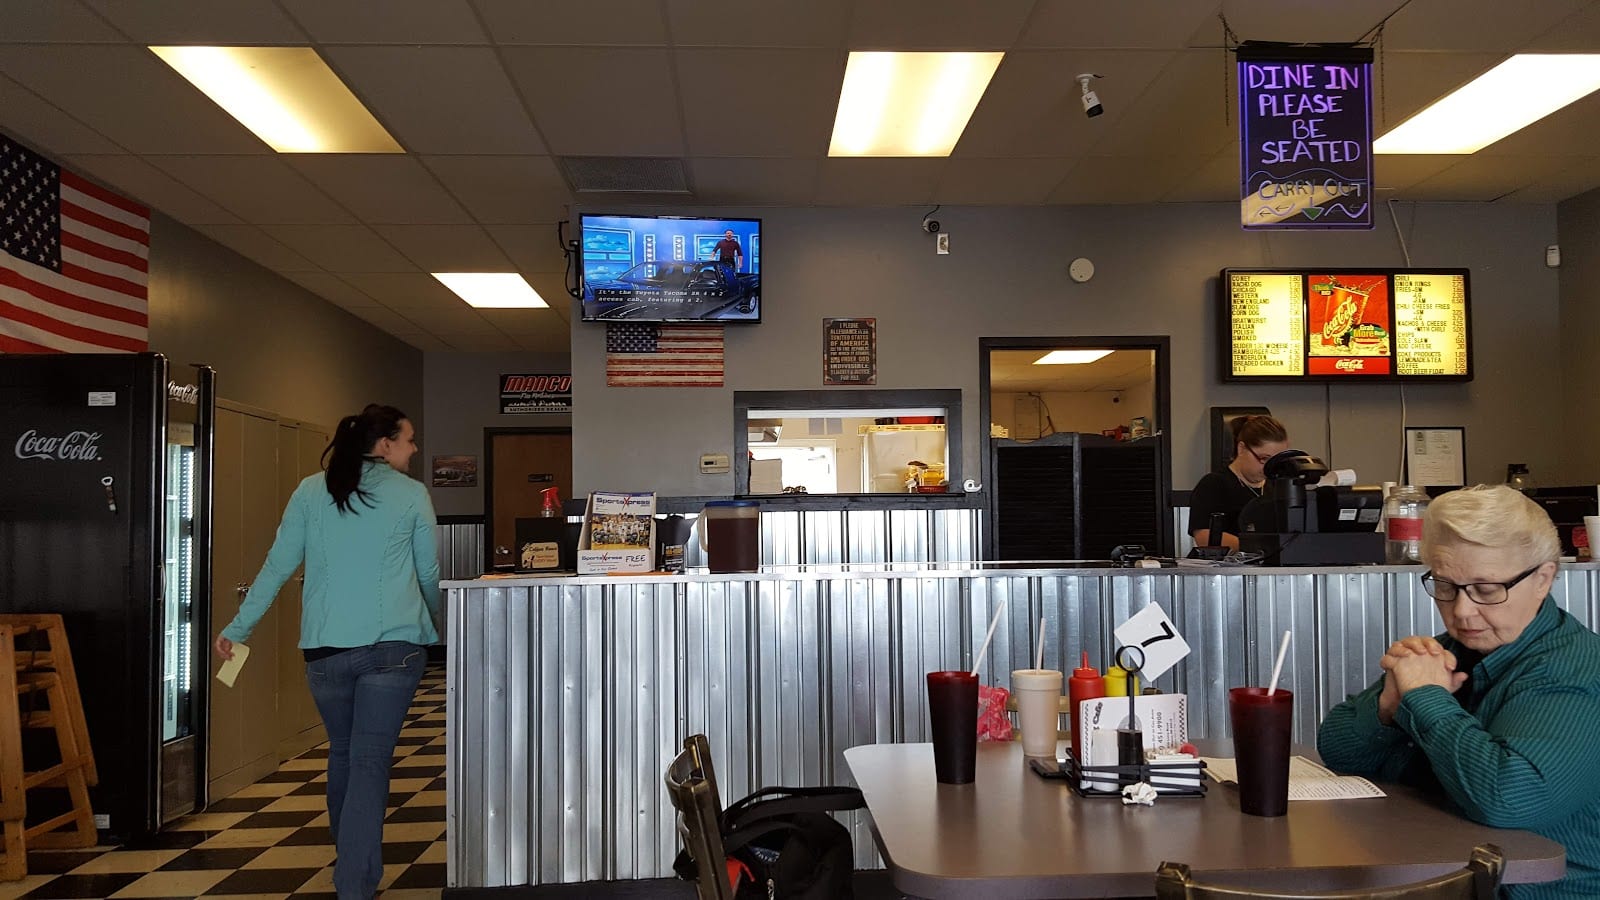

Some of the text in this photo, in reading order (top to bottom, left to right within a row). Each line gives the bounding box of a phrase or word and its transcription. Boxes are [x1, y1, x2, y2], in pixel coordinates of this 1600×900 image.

[1248, 64, 1359, 90] DINE IN
[1259, 93, 1343, 116] PLEASE
[1292, 118, 1327, 140] BE
[1261, 140, 1361, 164] SEATED
[1258, 178, 1367, 200] CARRY OUT
[503, 376, 572, 392] MANCO
[15, 429, 103, 461] Coca-Cola
[626, 554, 646, 562] FREE
[1140, 620, 1175, 648] 7
